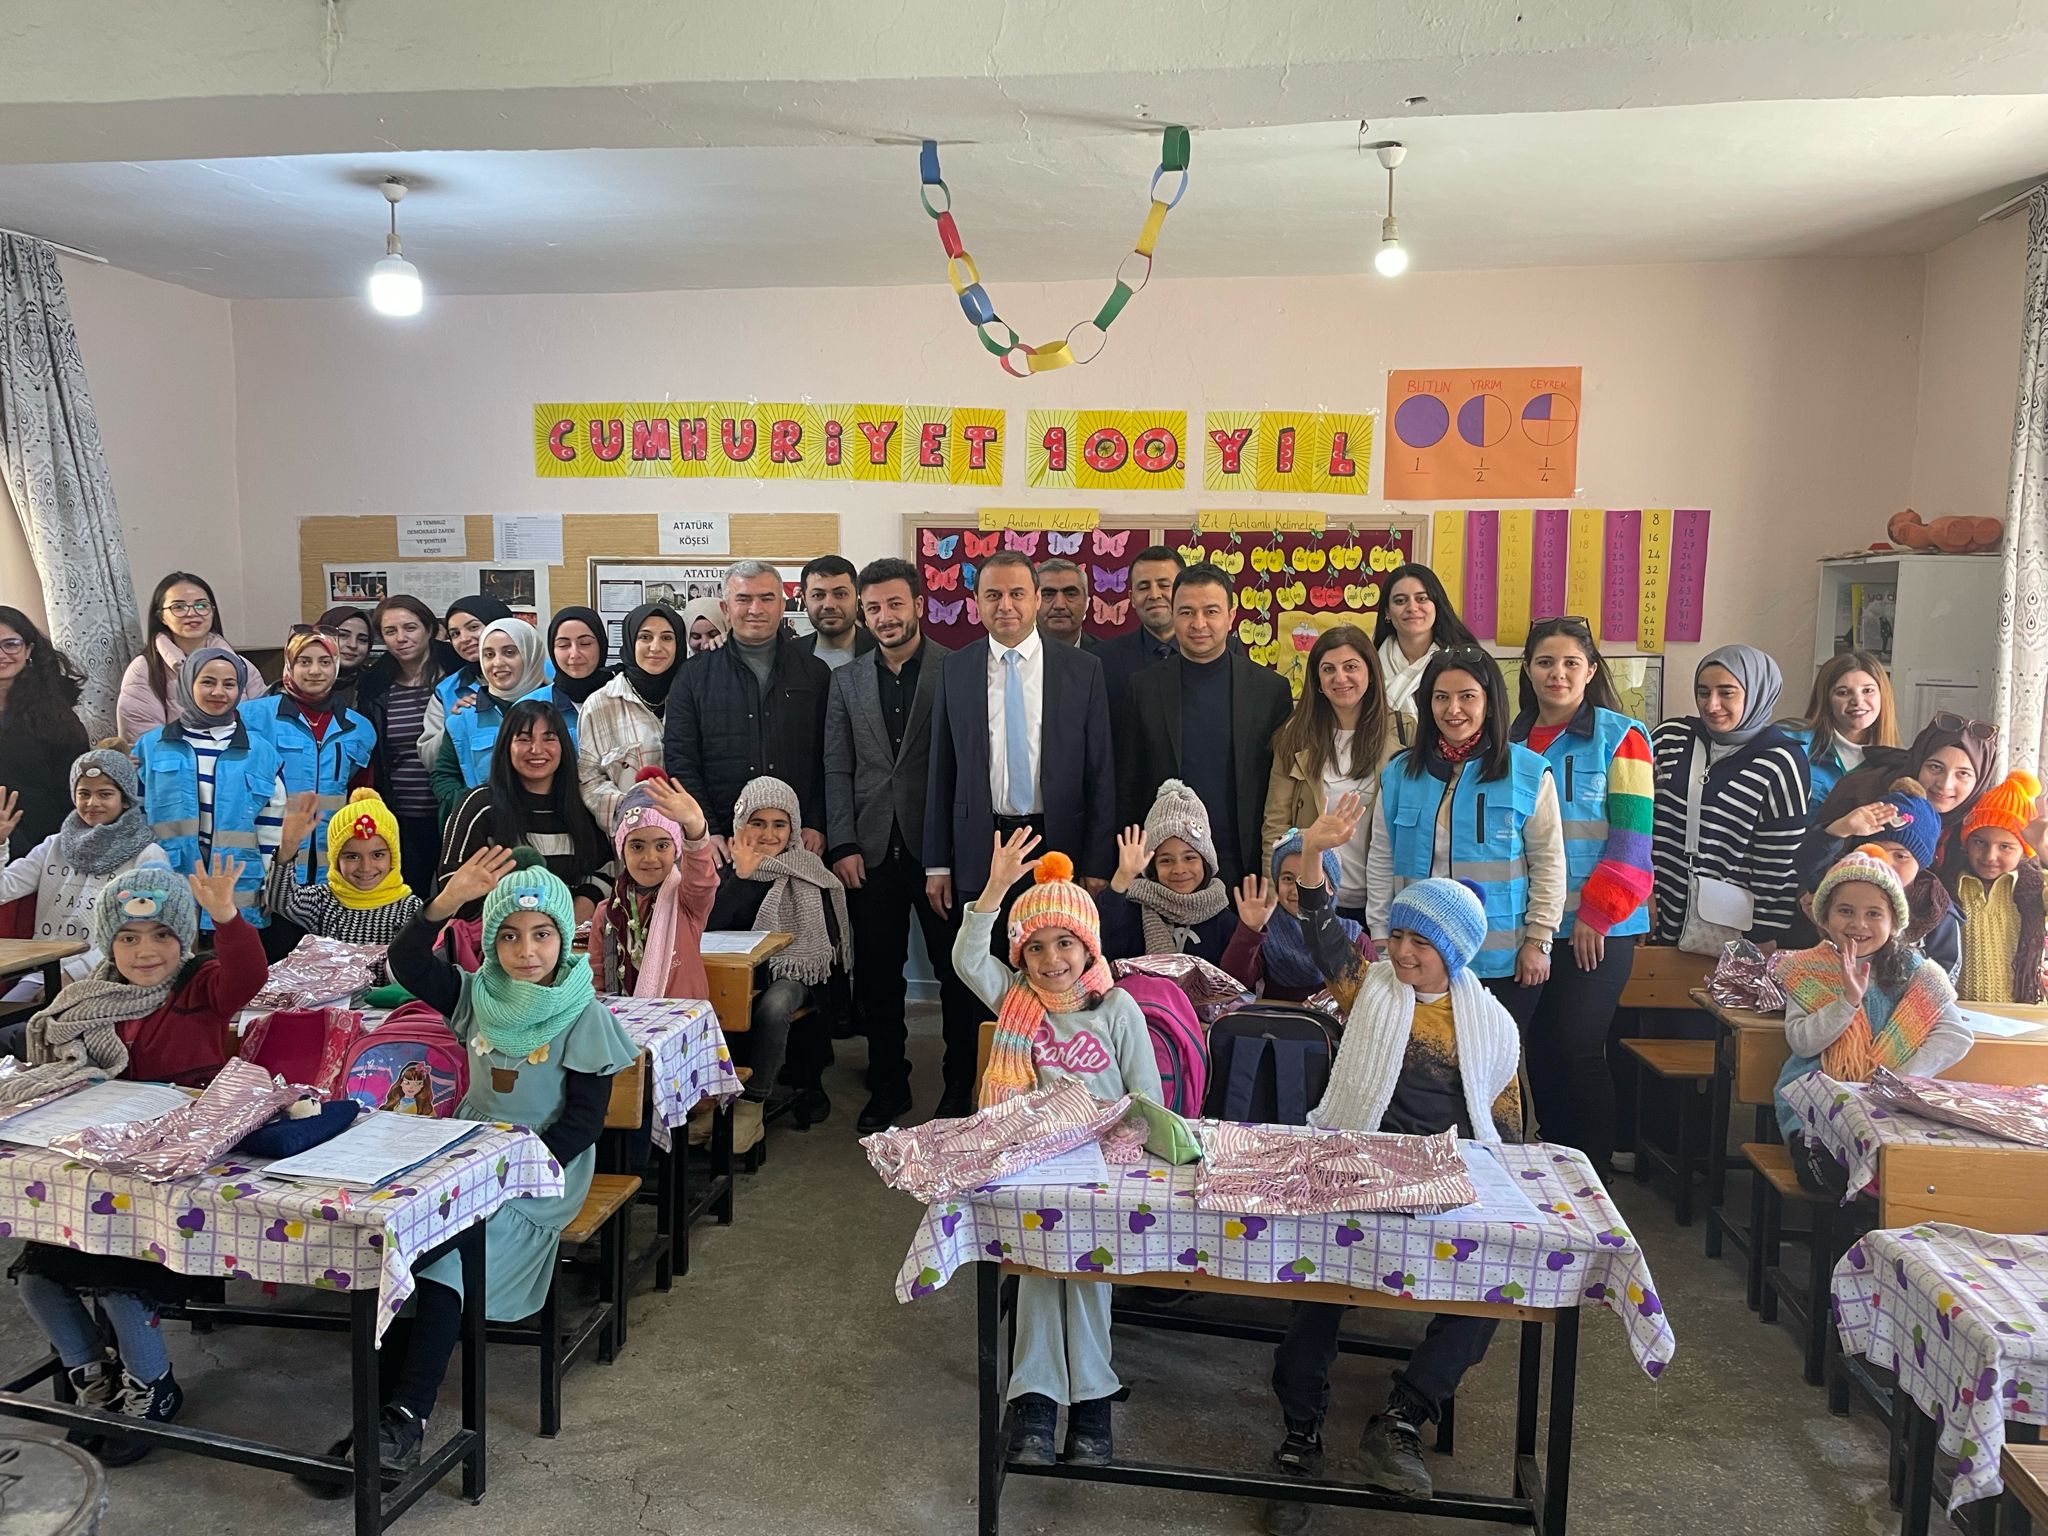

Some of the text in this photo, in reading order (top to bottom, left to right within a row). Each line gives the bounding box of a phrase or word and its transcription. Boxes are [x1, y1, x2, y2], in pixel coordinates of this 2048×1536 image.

[1208, 426, 1356, 477] YIL
[1476, 471, 1485, 482] 2
[1652, 513, 1660, 526] 8
[673, 520, 714, 530] ATATÜRK
[679, 534, 709, 547] KÖŞESİ
[1648, 534, 1659, 542] 16
[1648, 549, 1660, 560] 24
[684, 567, 725, 578] ATATÜR
[1646, 566, 1658, 574] 32
[1644, 603, 1656, 612] 56
[1644, 616, 1655, 624] 64
[1643, 640, 1654, 649] 80
